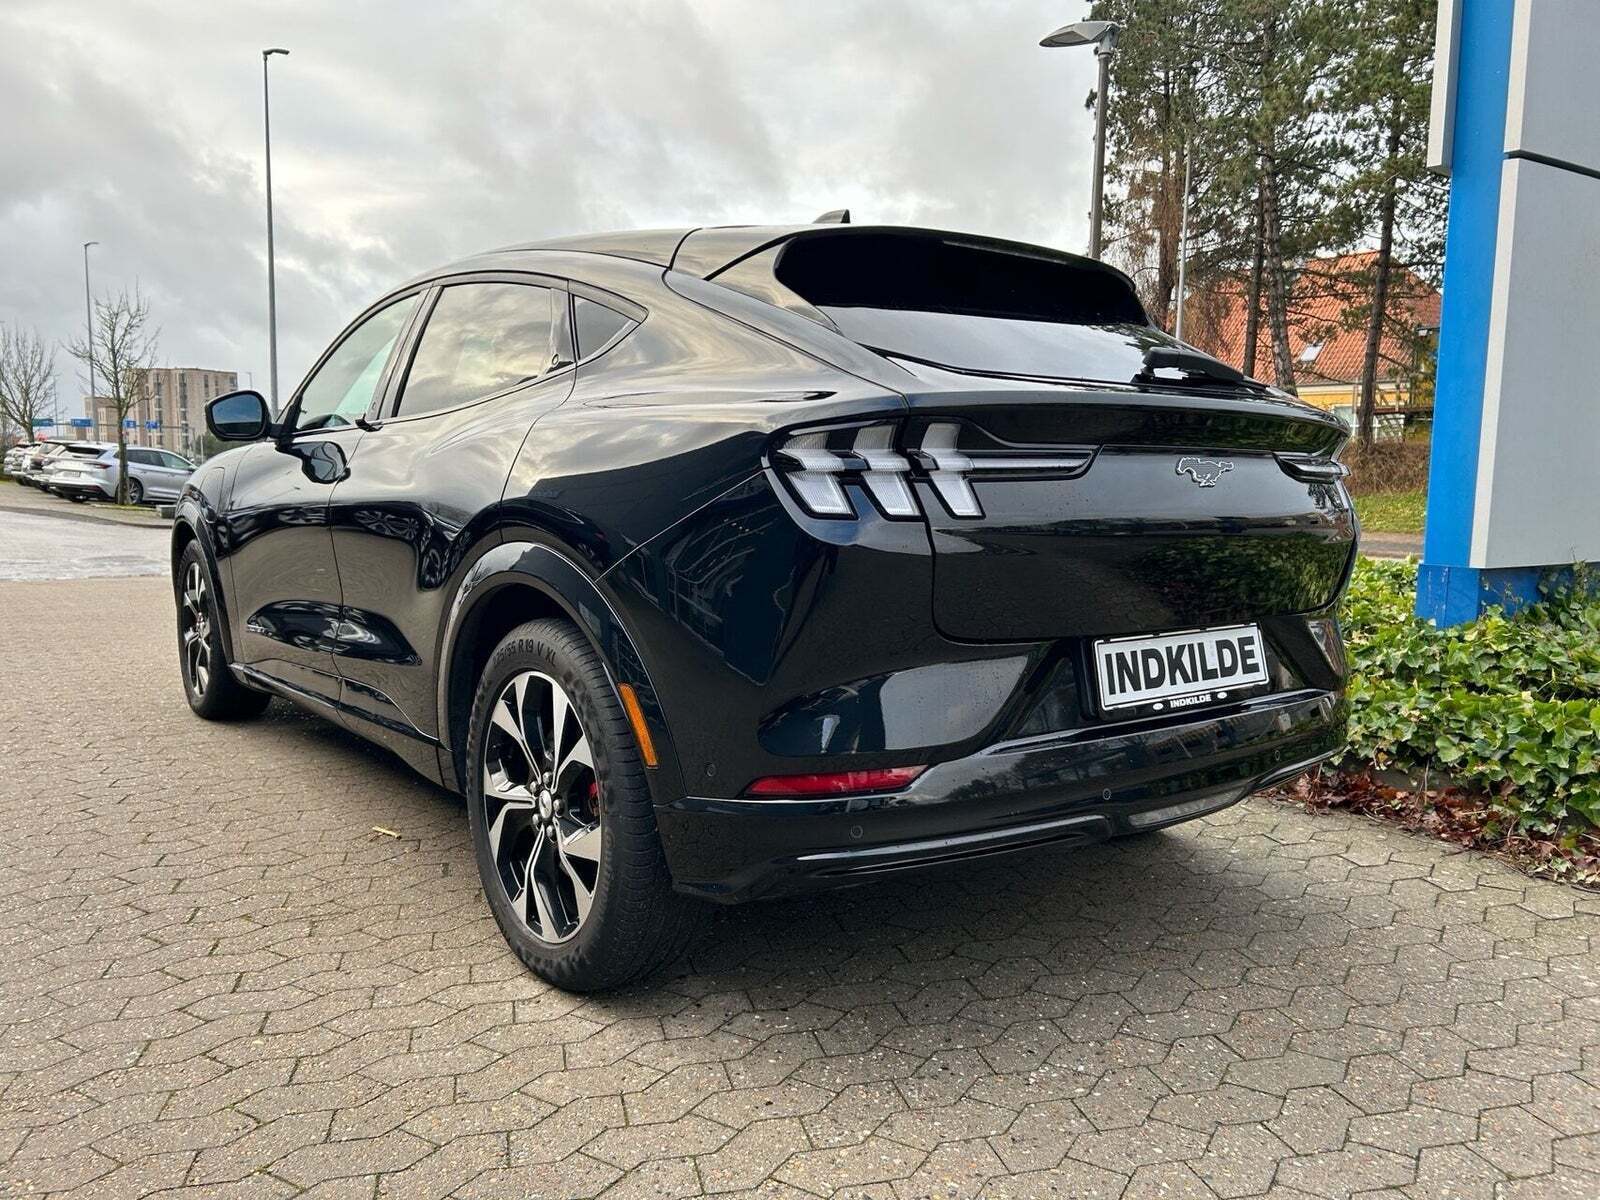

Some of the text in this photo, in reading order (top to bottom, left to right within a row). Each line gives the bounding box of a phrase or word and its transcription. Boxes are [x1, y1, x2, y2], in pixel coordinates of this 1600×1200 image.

[537, 640, 545, 657] V
[1104, 635, 1261, 696] INDKILDE
[1169, 694, 1212, 708] INDKILDE
